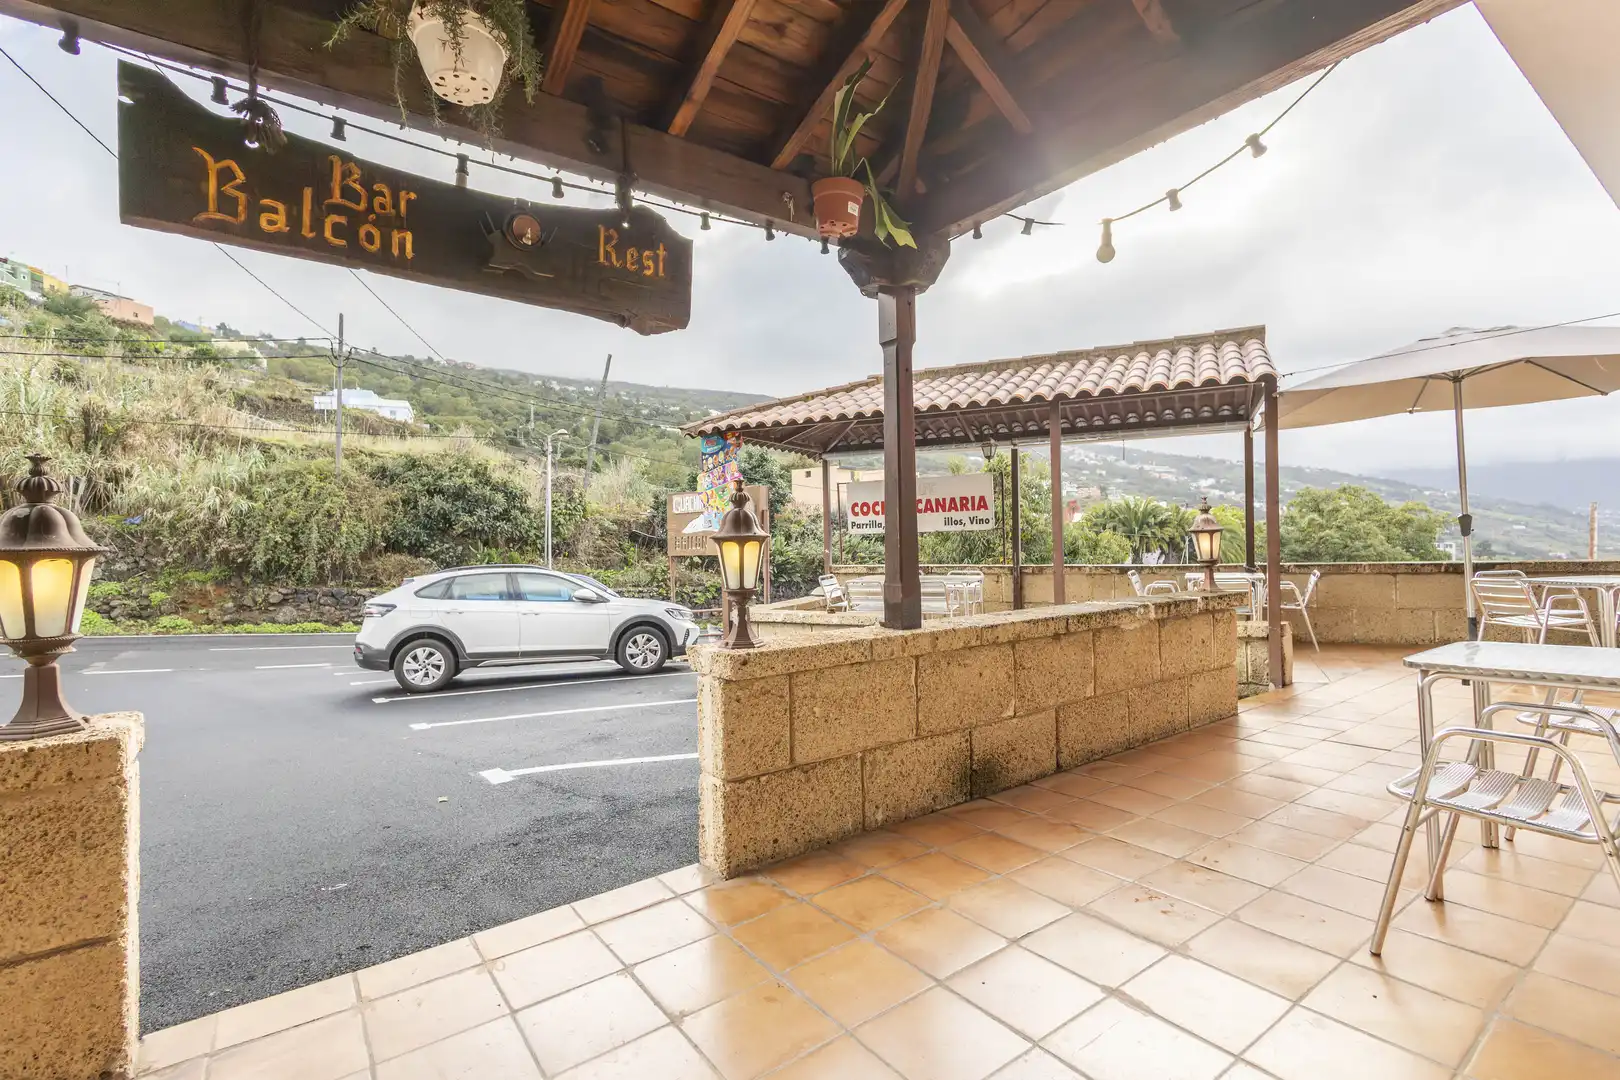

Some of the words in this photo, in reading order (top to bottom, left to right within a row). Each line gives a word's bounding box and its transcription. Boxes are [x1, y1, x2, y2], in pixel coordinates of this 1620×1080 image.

[192, 145, 415, 259] Balcón
[323, 155, 417, 217] Bar
[598, 224, 667, 277] Rest
[850, 500, 885, 517] COCI
[916, 495, 989, 514] CANARIA
[851, 520, 885, 530] Parrilla,
[969, 515, 990, 525] Vino
